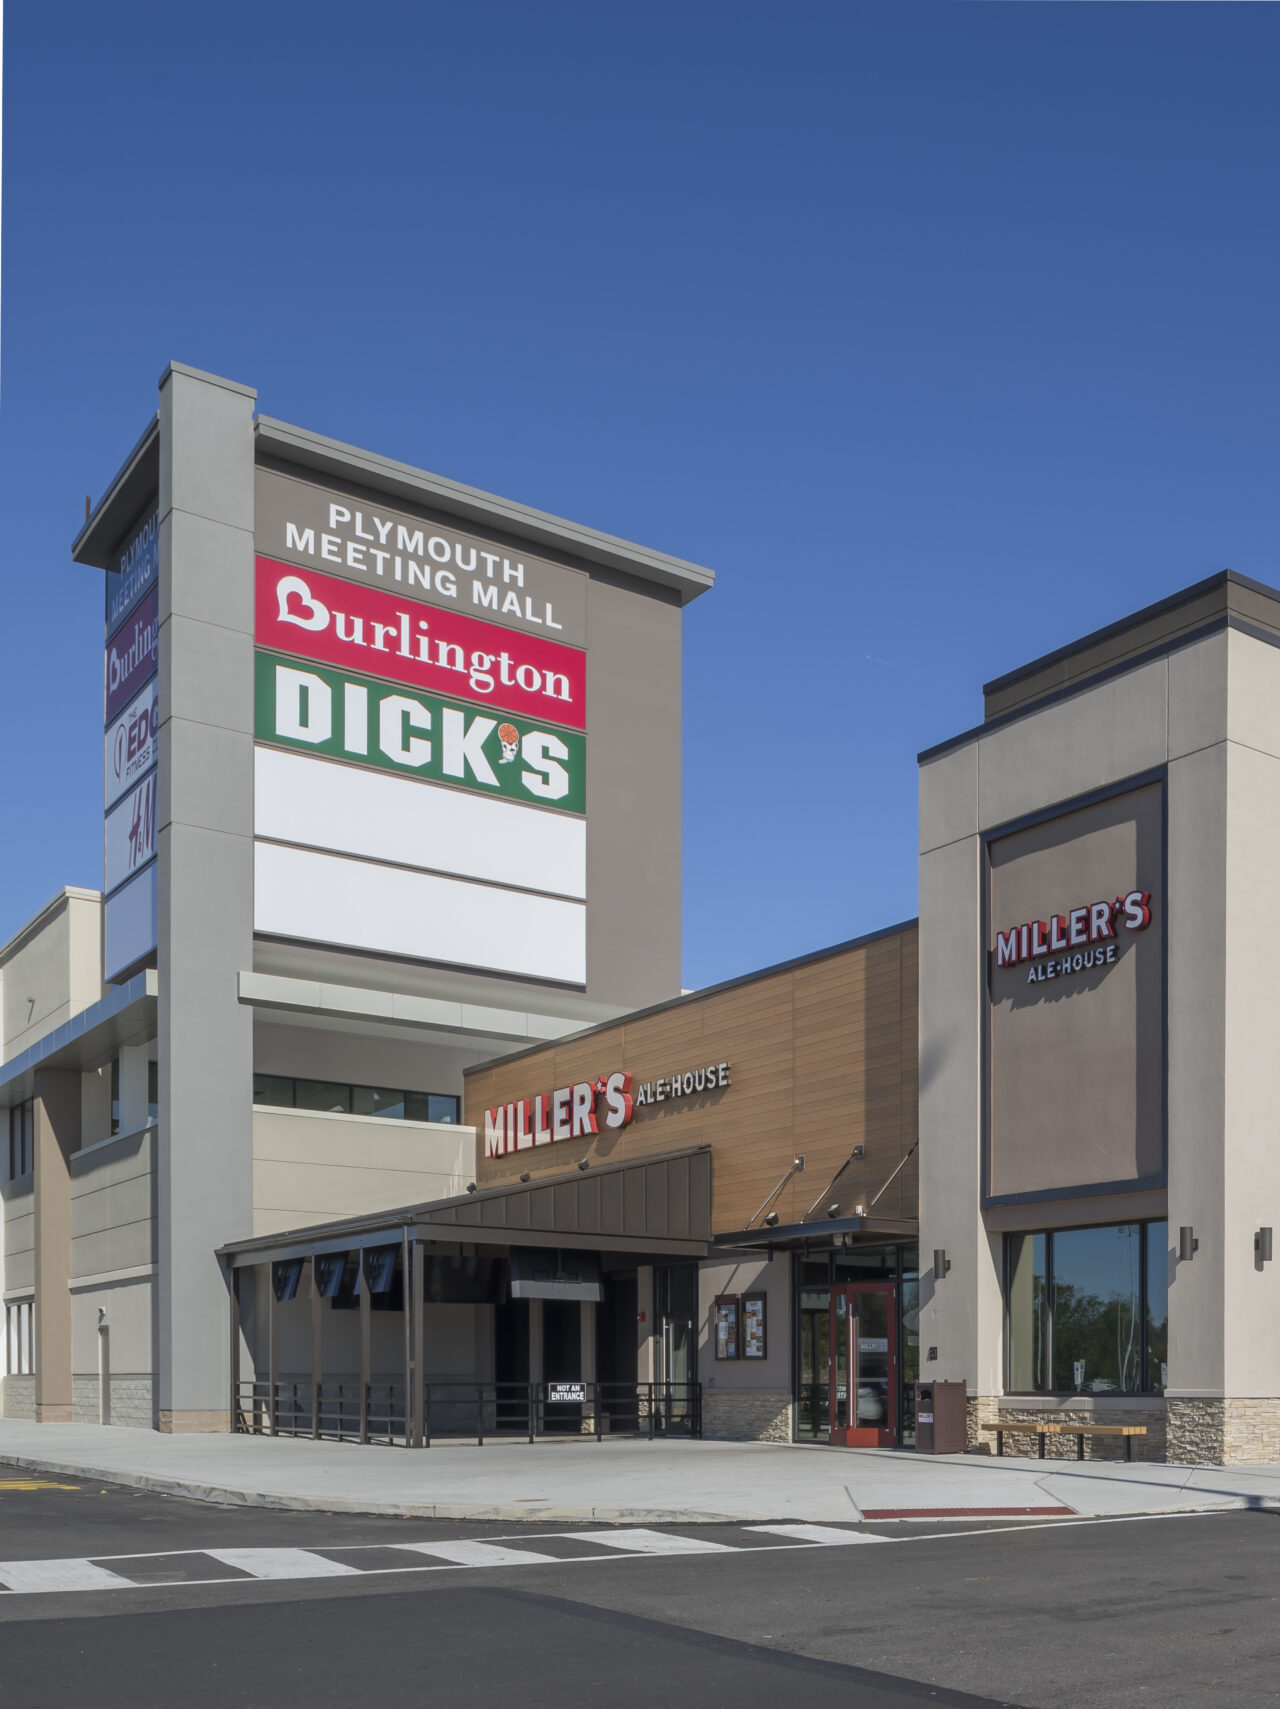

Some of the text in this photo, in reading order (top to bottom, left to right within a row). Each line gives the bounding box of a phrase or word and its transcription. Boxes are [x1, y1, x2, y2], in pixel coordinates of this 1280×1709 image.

[121, 508, 159, 580] PLYMOU
[286, 522, 562, 630] MEETING MALL
[329, 503, 525, 588] PLYMOUTH
[112, 554, 150, 621] MEETING
[109, 616, 158, 695] Burling
[276, 575, 573, 702] Burlington
[127, 696, 158, 763] EDG
[275, 664, 569, 800] DICK'S
[997, 890, 1151, 966] MILLER'S
[484, 1071, 632, 1158] MILLER'S
[551, 1392, 584, 1400] ENTRANCE
